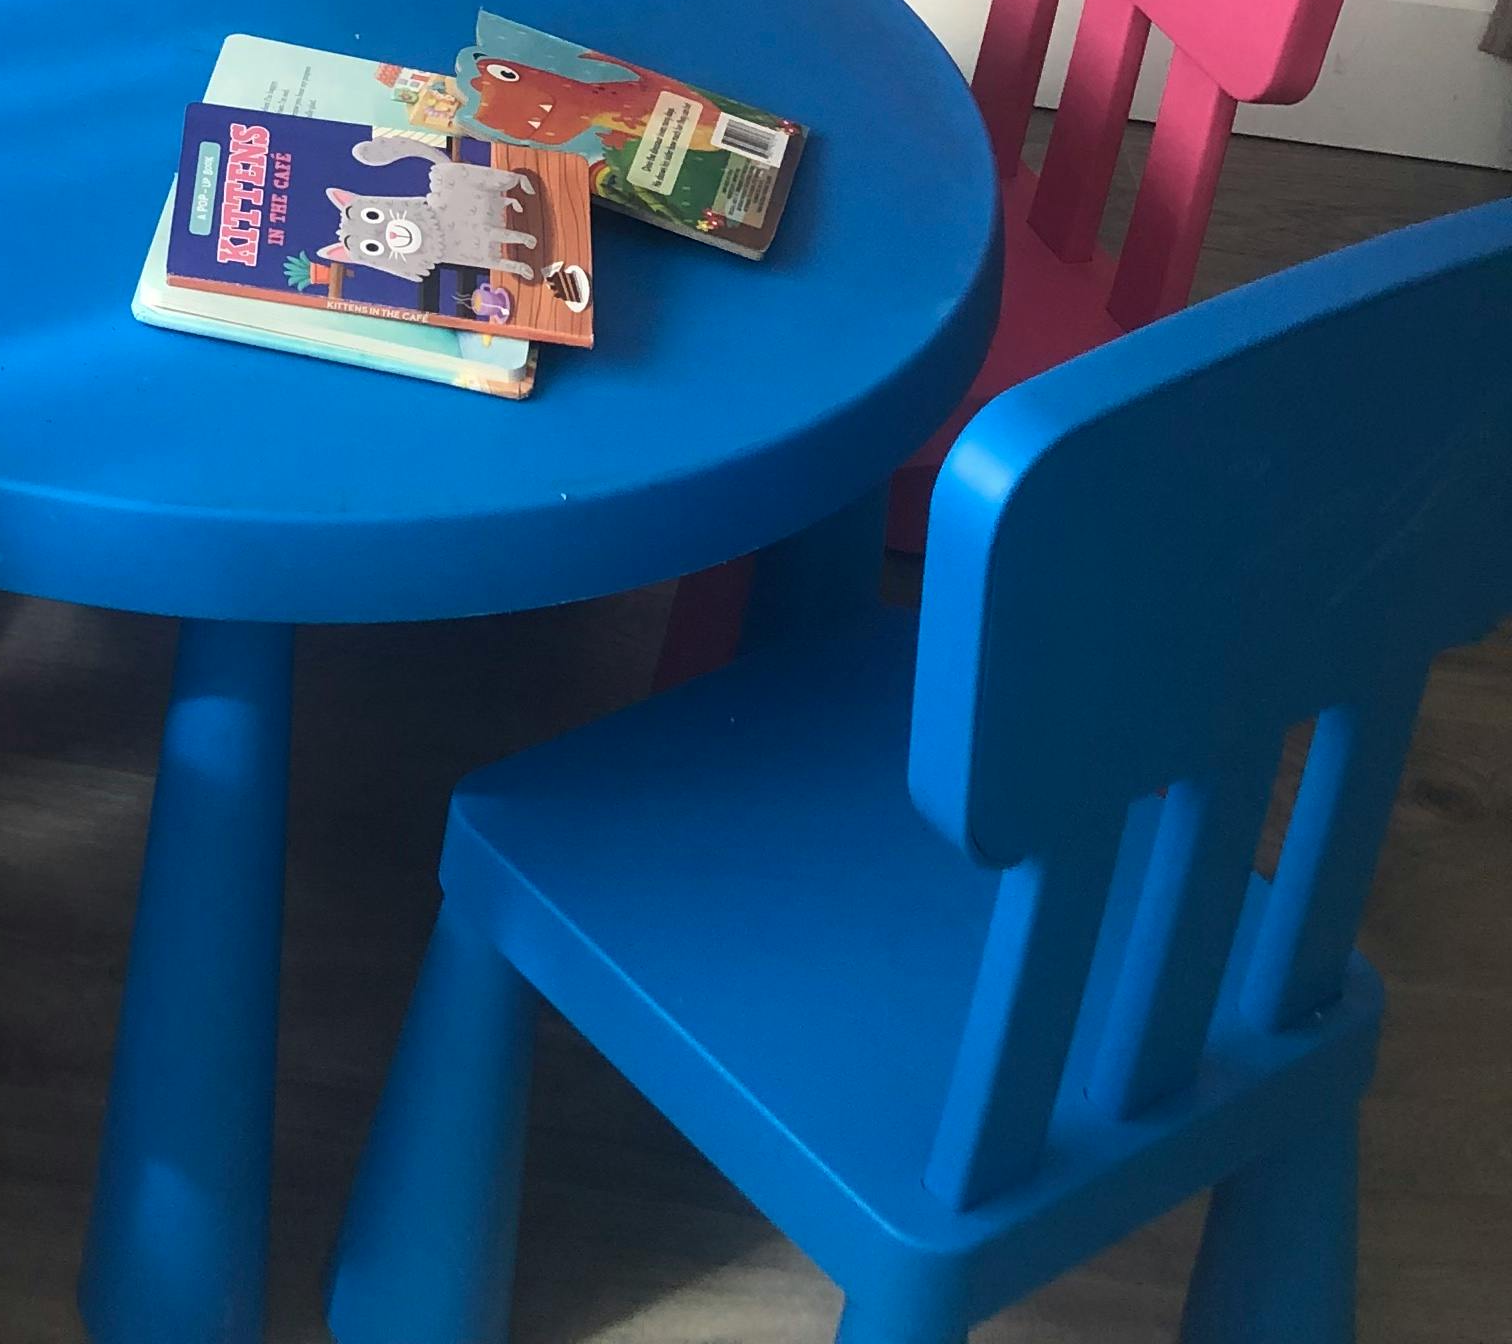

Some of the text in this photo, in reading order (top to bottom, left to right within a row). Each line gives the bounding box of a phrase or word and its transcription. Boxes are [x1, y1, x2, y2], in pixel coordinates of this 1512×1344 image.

[204, 156, 214, 174] BOOK
[217, 123, 270, 267] KITTENS
[268, 152, 292, 247] IN THE CAFÉ
[327, 301, 367, 314] KITTENS
[383, 309, 399, 319] THE
[402, 311, 429, 323] CAFÉ
